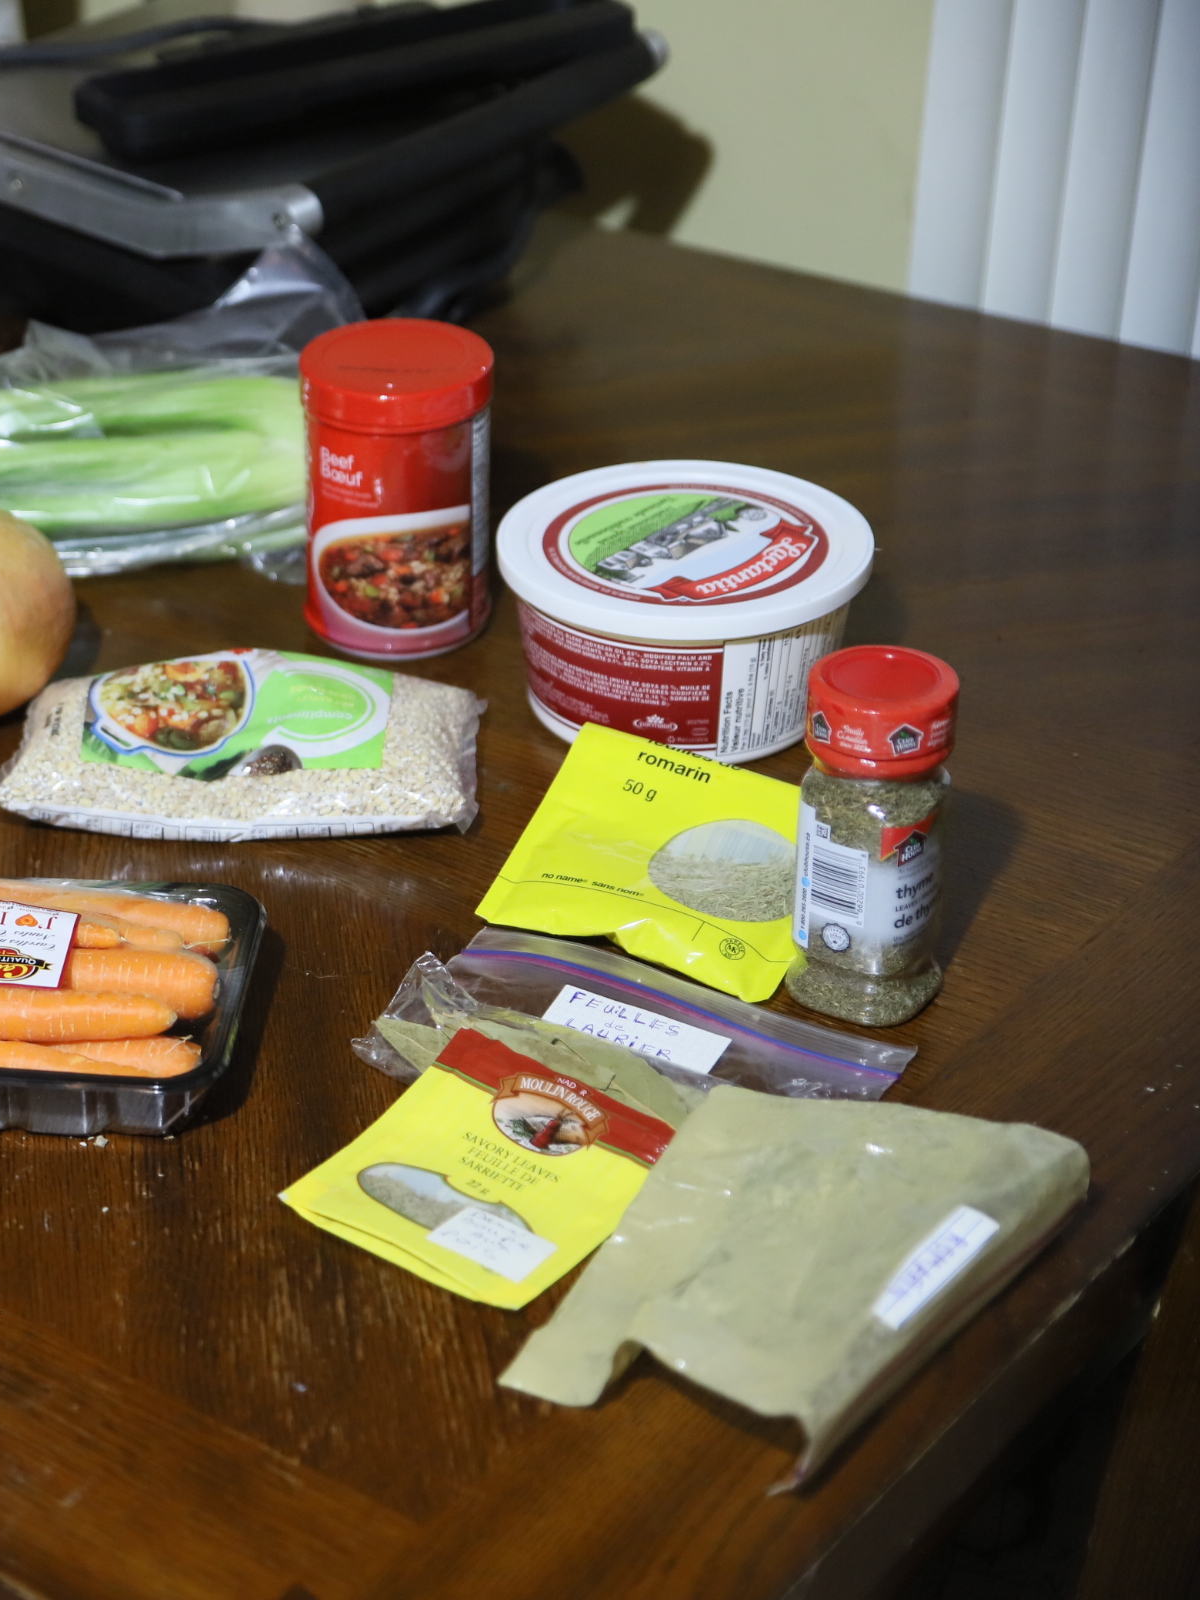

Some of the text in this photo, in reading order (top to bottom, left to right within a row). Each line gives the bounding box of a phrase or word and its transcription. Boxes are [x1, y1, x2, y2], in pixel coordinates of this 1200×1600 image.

[320, 445, 354, 469] Beef
[320, 462, 363, 486] Bœuf
[694, 533, 807, 596] Lactantia
[266, 709, 353, 724] compliments
[720, 691, 734, 753] Nutrition Facts
[731, 688, 745, 752] Valeur nutritive
[637, 749, 712, 783] romarin
[622, 779, 658, 802] 50 g
[901, 845, 924, 863] HOUSE
[904, 840, 921, 854] CLUB
[541, 872, 555, 880] no
[592, 880, 615, 889] sans
[895, 872, 934, 900] thyme
[857, 891, 865, 914] 66200
[0, 911, 11, 926] I
[893, 912, 912, 929] de
[13, 930, 56, 941] Nantes
[604, 1020, 626, 1032] de
[519, 1076, 602, 1122] MOULIN ROUGE
[462, 1131, 562, 1184] SAVORY LEAVES
[467, 1146, 542, 1186] FEUILLE DE
[458, 1156, 527, 1193] SARRIETTE
[465, 1179, 491, 1196] 22 g
